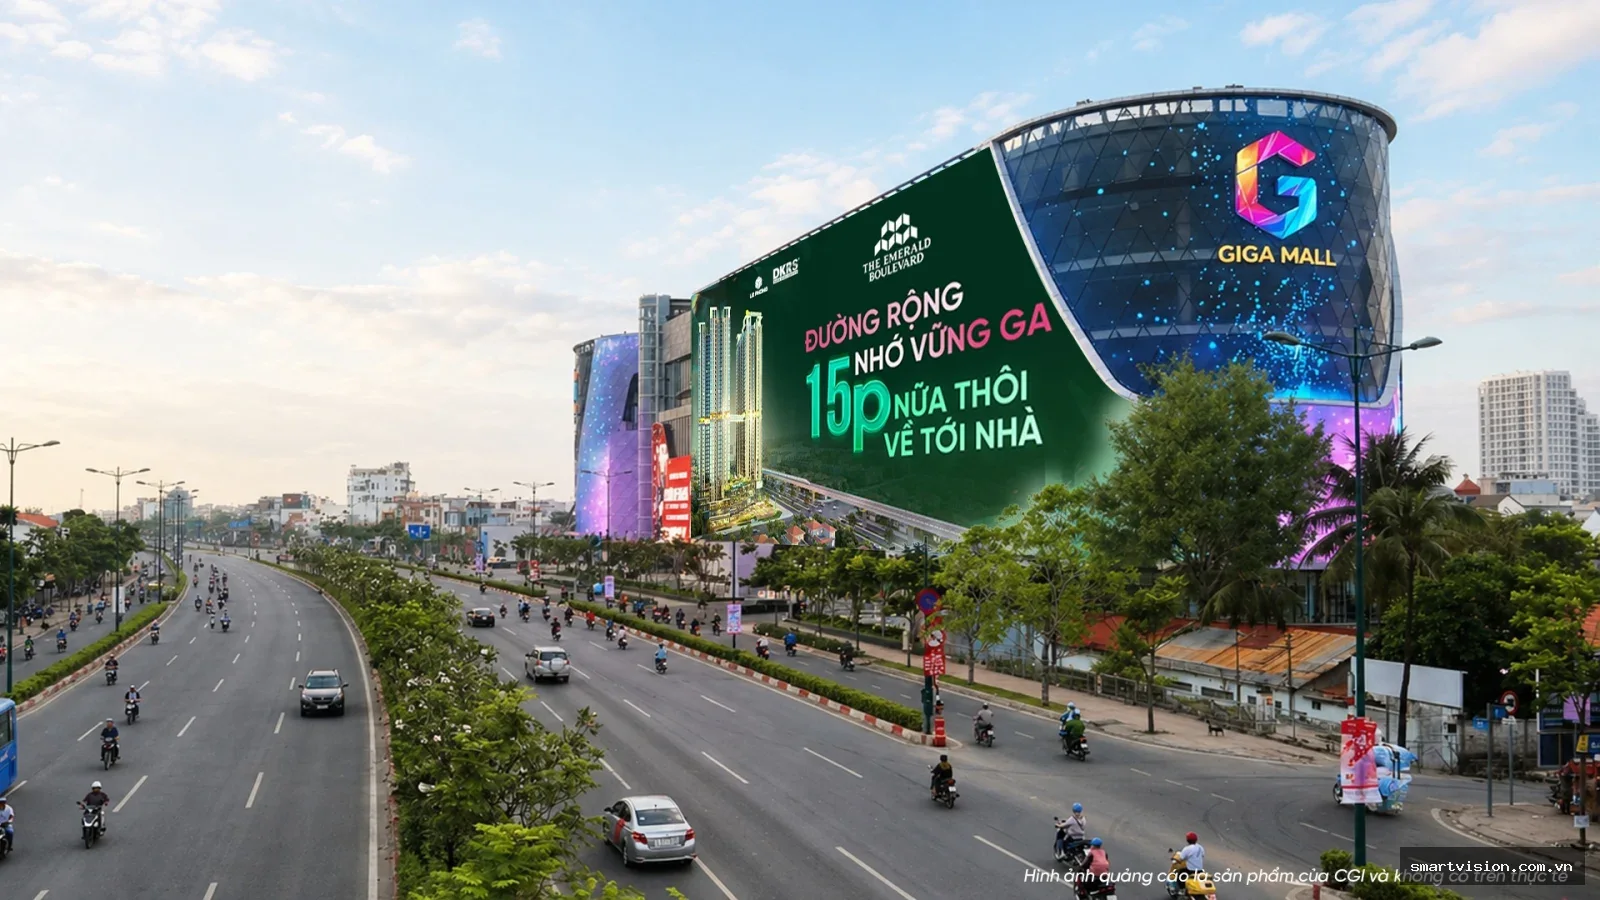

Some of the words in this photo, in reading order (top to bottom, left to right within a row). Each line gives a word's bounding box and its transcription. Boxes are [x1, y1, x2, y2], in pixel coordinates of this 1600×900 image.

[773, 258, 799, 280] DKRS
[863, 258, 881, 274] THE
[883, 237, 931, 266] EMERALD
[869, 252, 924, 282] BOULEVARD
[1218, 244, 1275, 263] GIGA
[1281, 246, 1337, 266] MALL
[804, 309, 880, 353] ĐƯỜNG
[887, 281, 964, 330] RỘNG
[854, 336, 905, 375] NHỚ
[910, 318, 991, 362] VỮNG
[1000, 302, 1052, 341] GA
[806, 355, 891, 453] 15p
[894, 381, 947, 420] NỮA
[954, 364, 1028, 410] THÔI
[883, 418, 913, 458] VỀ
[920, 416, 965, 453] TỚI
[975, 405, 1043, 449] NHÀ
